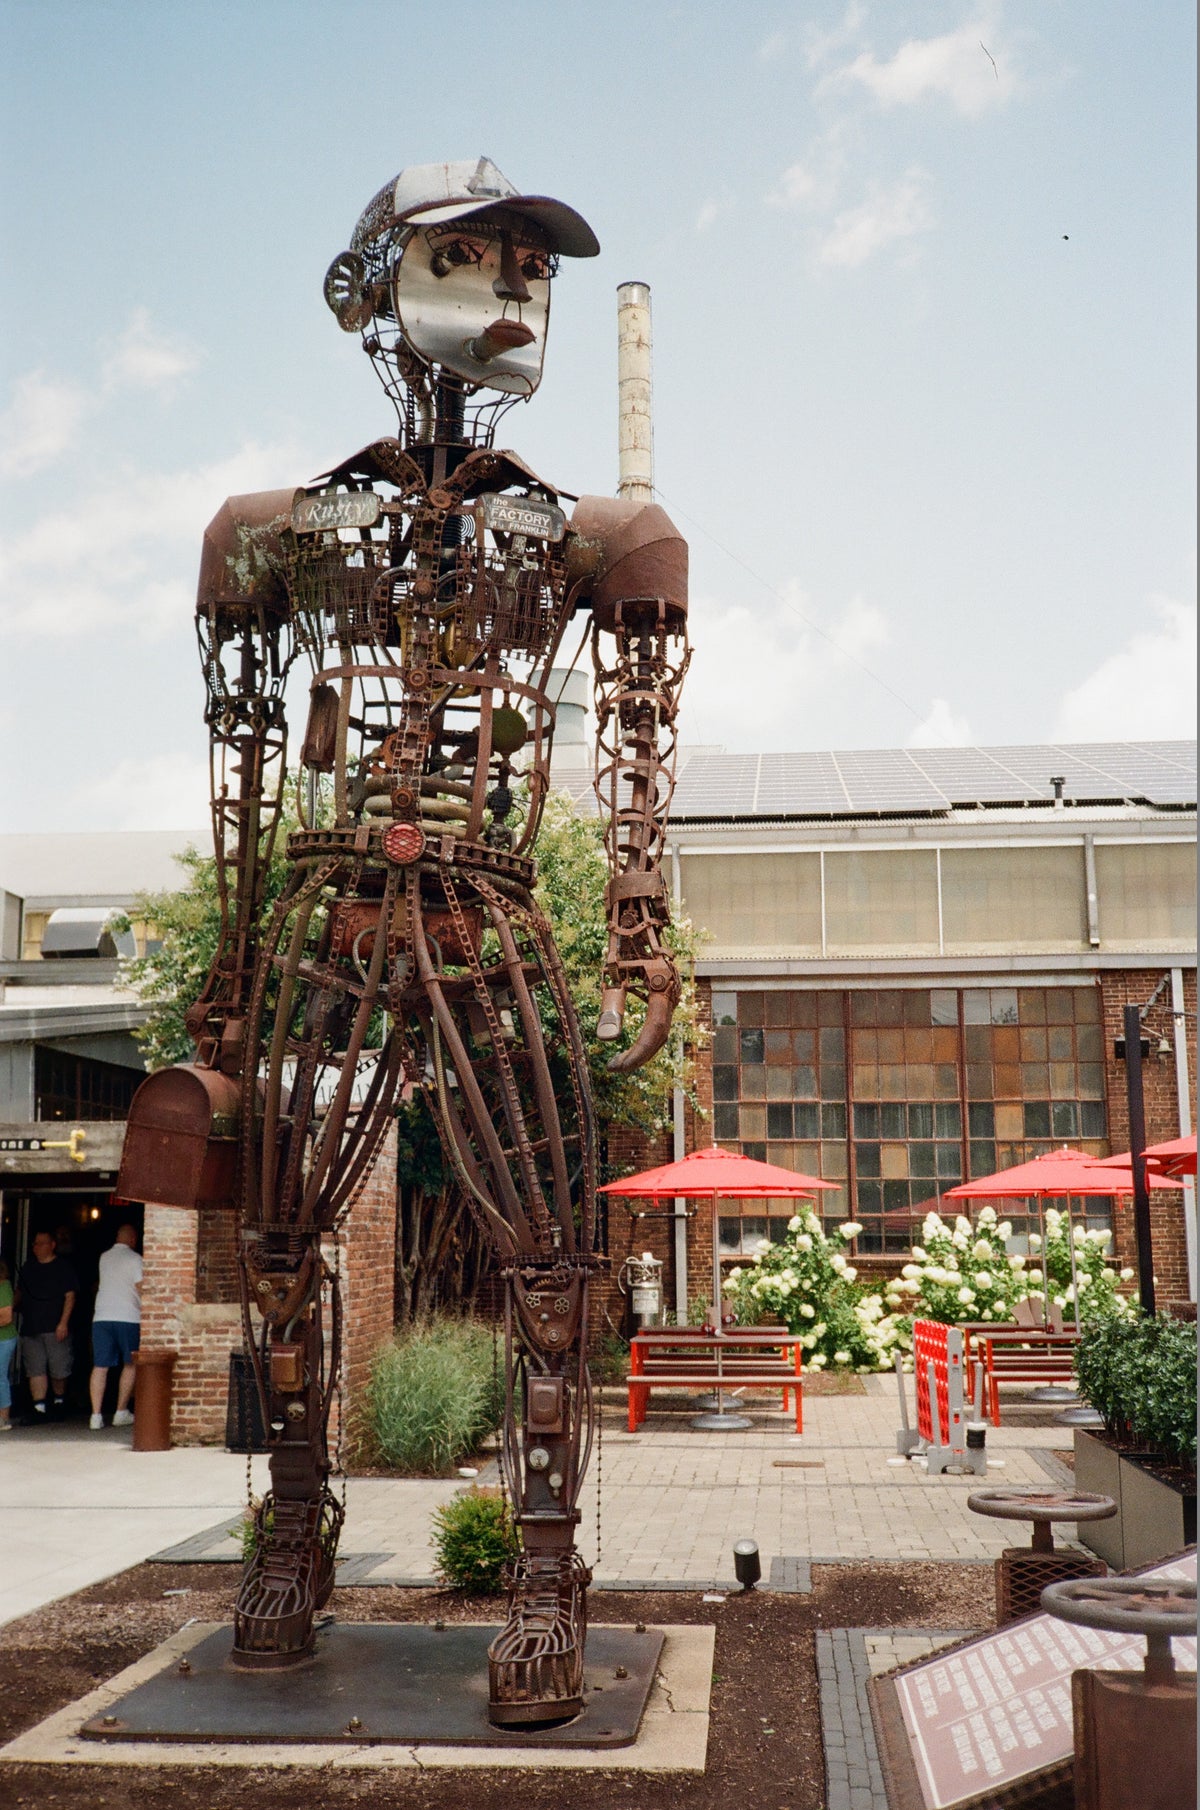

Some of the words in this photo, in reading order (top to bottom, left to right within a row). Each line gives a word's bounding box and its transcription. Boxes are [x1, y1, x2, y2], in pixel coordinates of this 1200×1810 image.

[493, 497, 508, 506] the
[491, 507, 550, 527] FACTORY
[509, 522, 549, 537] FRANKLIN
